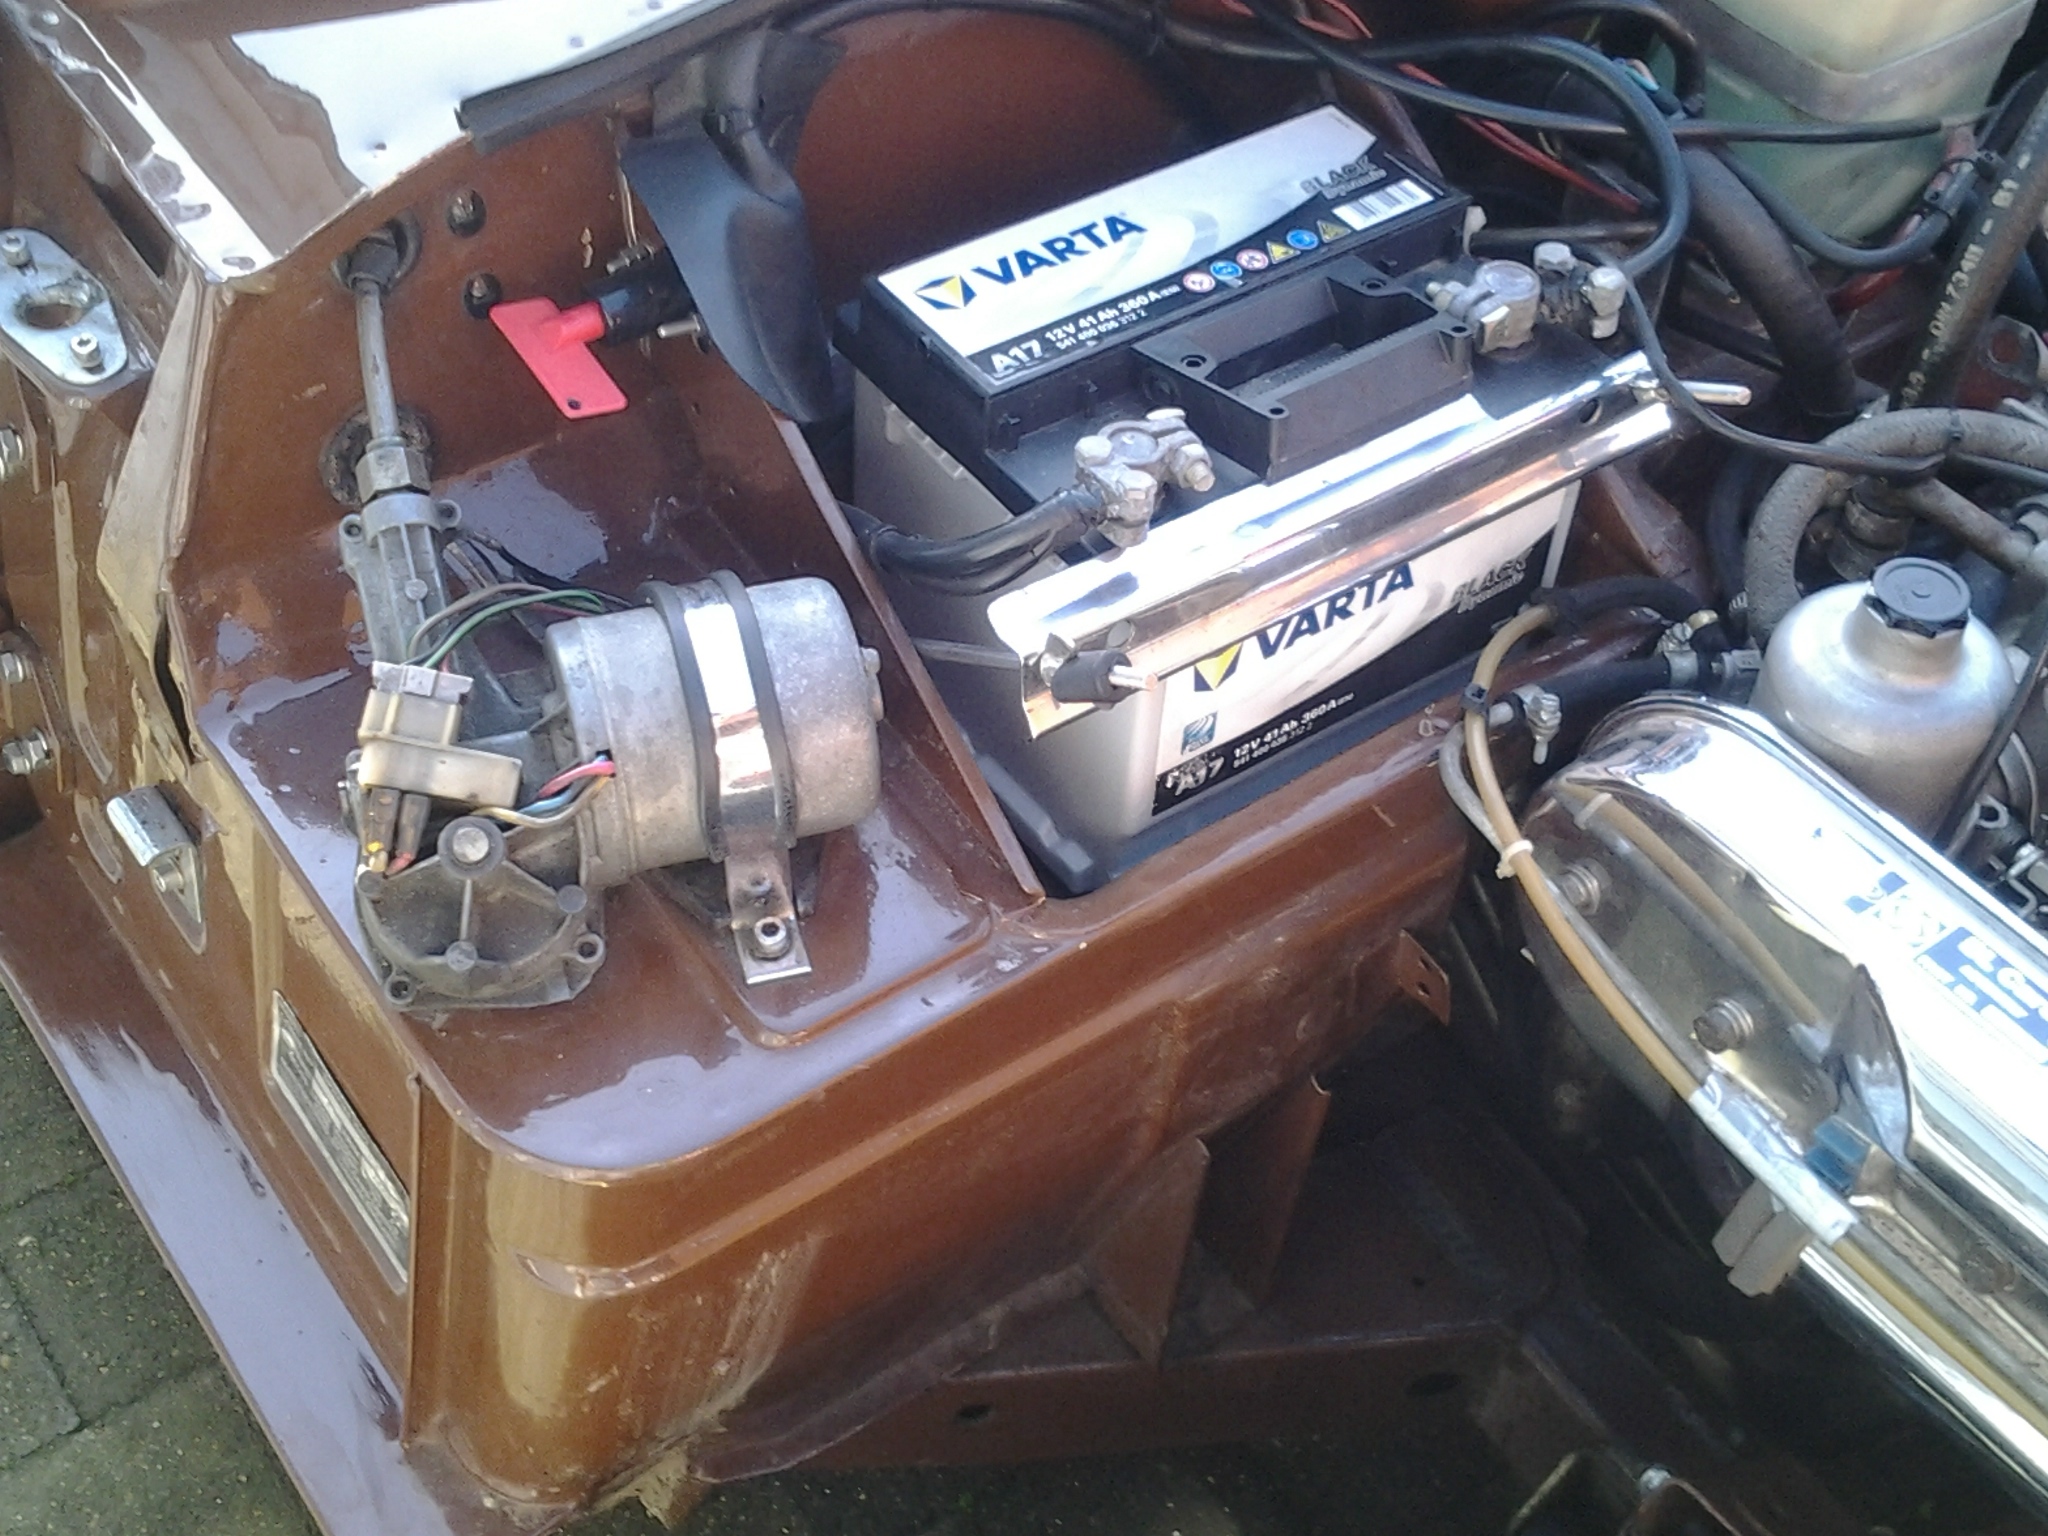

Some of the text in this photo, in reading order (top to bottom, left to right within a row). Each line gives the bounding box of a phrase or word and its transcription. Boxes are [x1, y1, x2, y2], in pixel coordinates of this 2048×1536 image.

[1300, 155, 1379, 194] BLACK
[971, 215, 1146, 285] VARTA
[990, 339, 1043, 373] A17
[1045, 322, 1075, 341] 12V
[1255, 561, 1415, 659] VARTA
[1233, 737, 1260, 758] 12V
